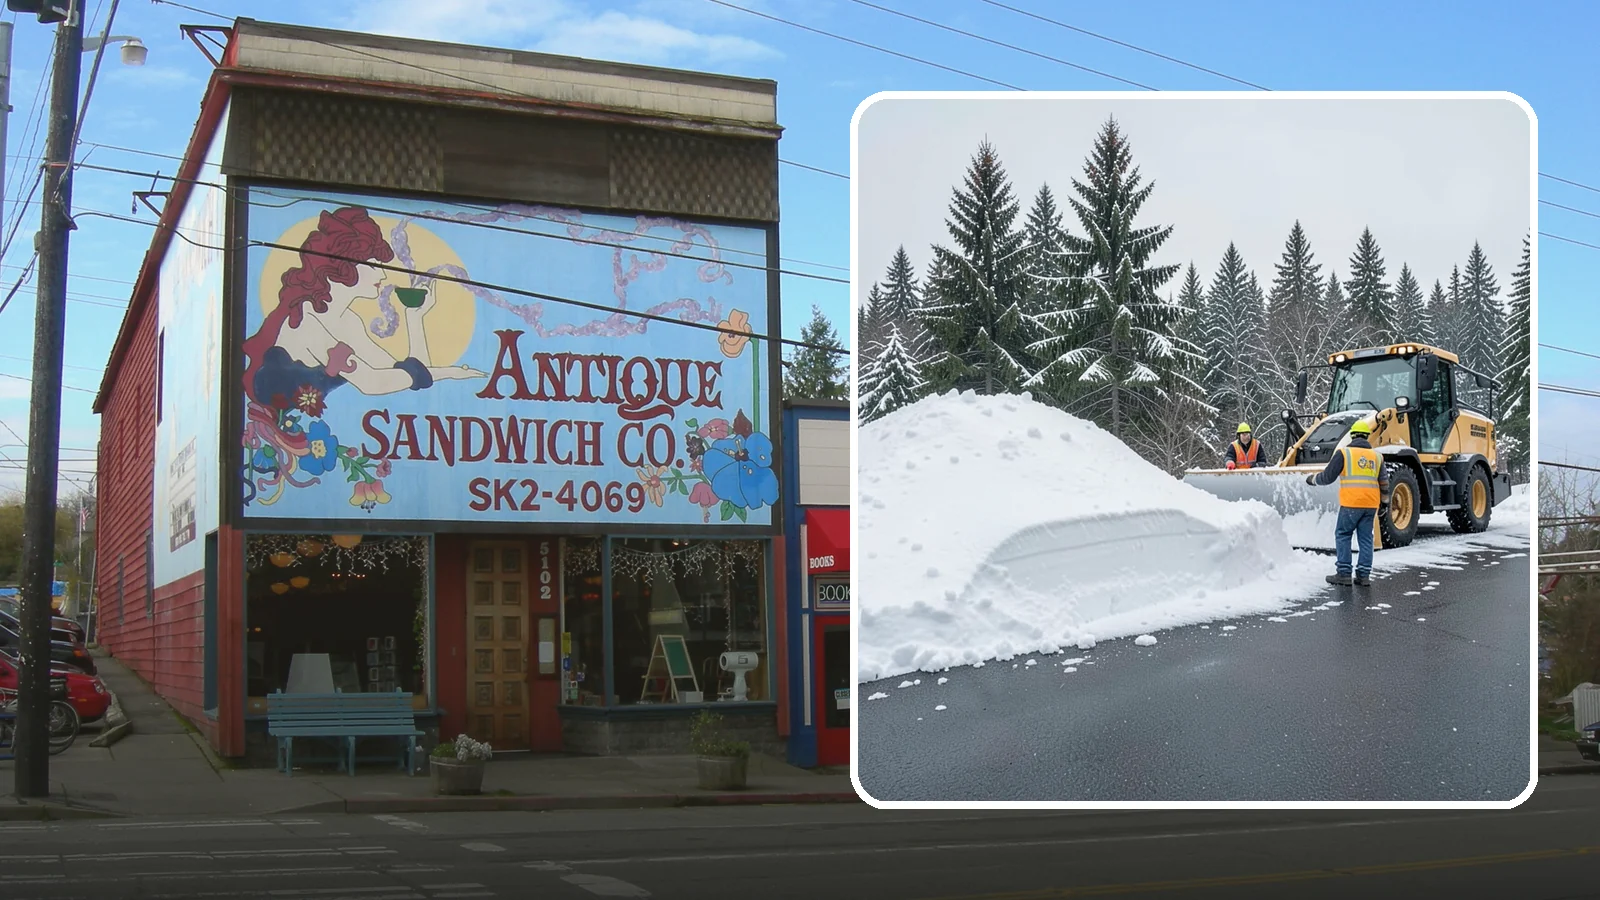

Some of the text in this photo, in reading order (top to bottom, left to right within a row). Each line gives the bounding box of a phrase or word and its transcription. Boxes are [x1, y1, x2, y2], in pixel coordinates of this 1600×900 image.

[475, 328, 724, 421] ANTIQUE
[361, 408, 685, 469] SANDWICH CO.
[468, 476, 646, 513] SK2-4069
[540, 541, 551, 600] 5102
[809, 555, 835, 569] BOOKS
